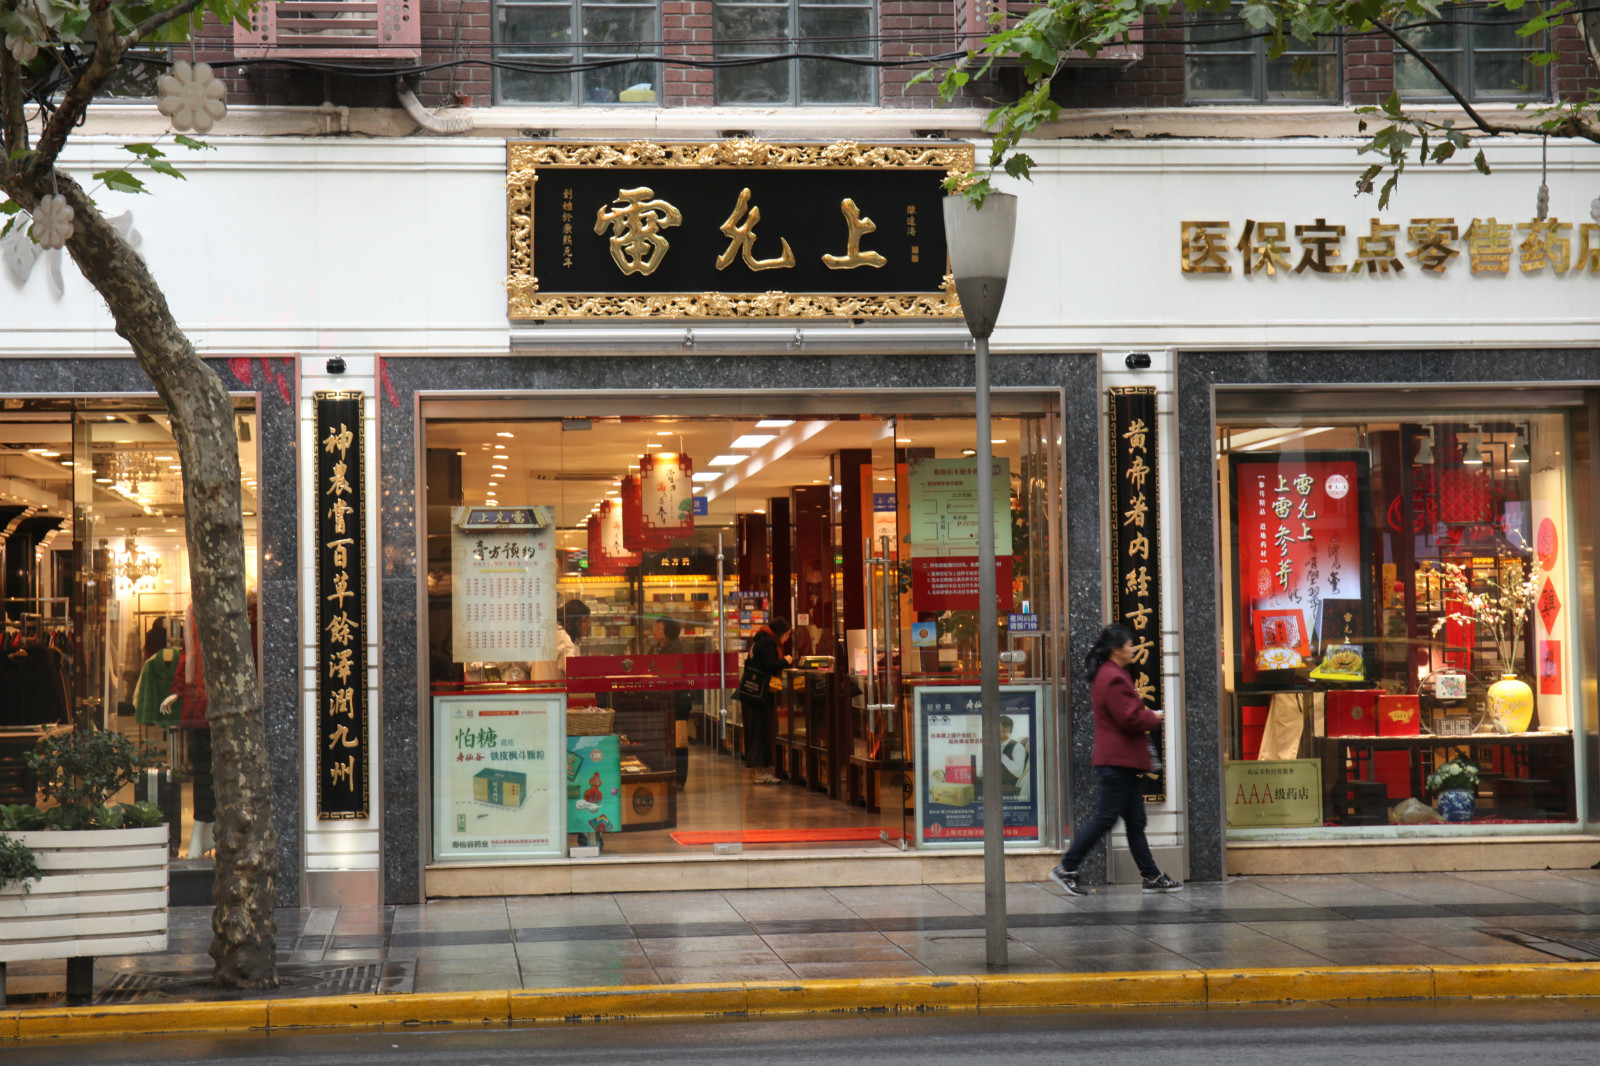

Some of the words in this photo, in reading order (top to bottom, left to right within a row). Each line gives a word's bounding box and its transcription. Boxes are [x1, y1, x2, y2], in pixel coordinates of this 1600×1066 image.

[593, 185, 888, 276] 雷允上
[1293, 473, 1318, 541] 雷允上
[473, 540, 536, 561] 膏方预约
[1009, 614, 1038, 622] 夜间购药
[1009, 622, 1038, 630] 请按门铃
[1342, 612, 1353, 645] 雷允上
[455, 727, 498, 750] 怕糖
[490, 750, 545, 761] 铁皮枫斗颗粒
